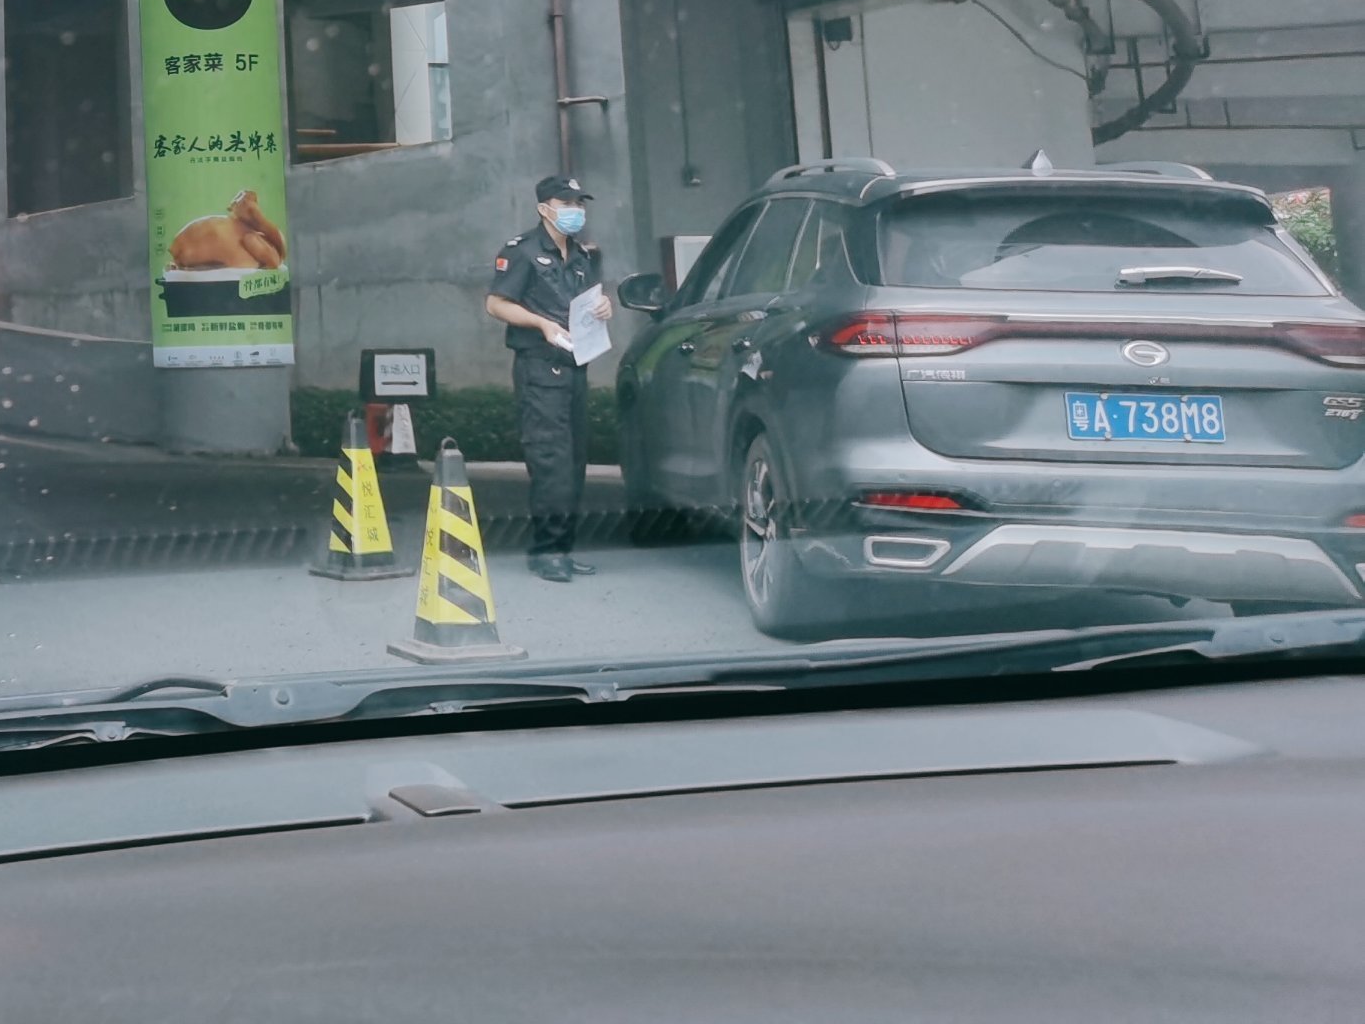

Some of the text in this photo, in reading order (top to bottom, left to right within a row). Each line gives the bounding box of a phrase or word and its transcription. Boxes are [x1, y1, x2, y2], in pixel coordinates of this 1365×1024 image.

[164, 52, 259, 77] 客家菜 5F
